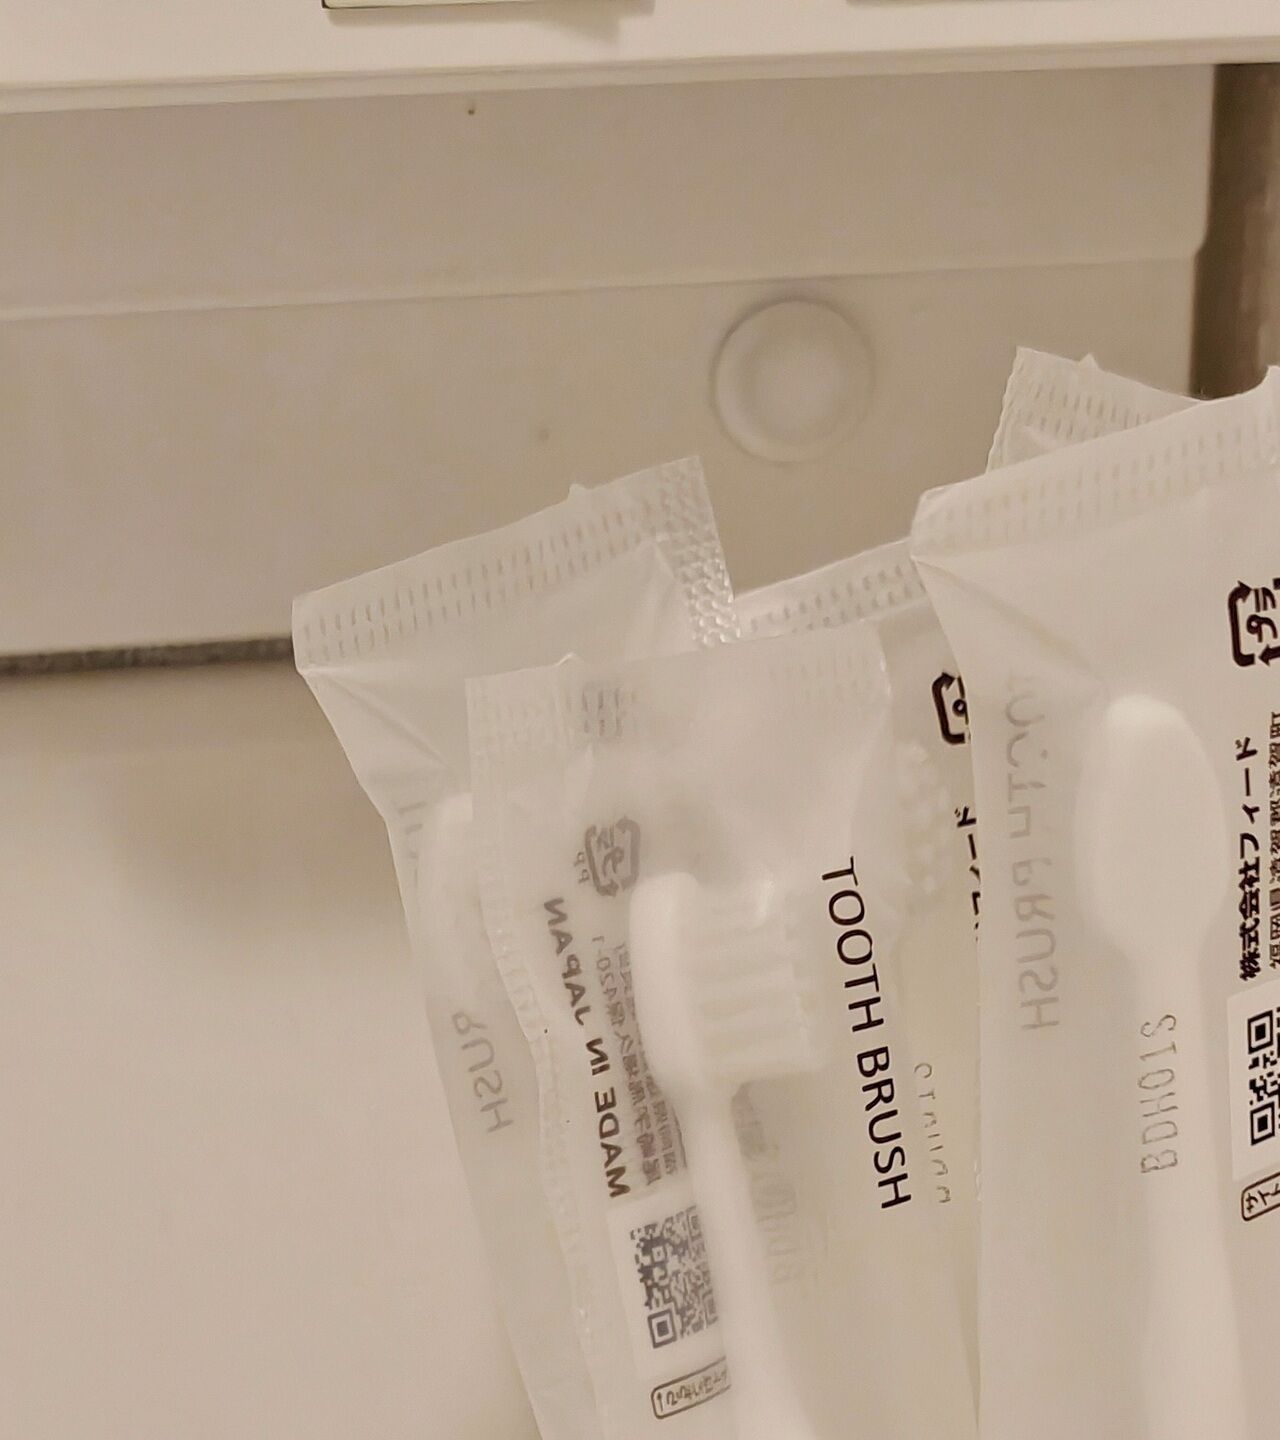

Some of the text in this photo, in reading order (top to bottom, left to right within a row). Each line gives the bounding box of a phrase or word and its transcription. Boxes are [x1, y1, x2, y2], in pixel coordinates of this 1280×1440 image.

[1235, 736, 1262, 981] 株式会社フィード
[820, 856, 912, 1210] TOOTH BRUSH
